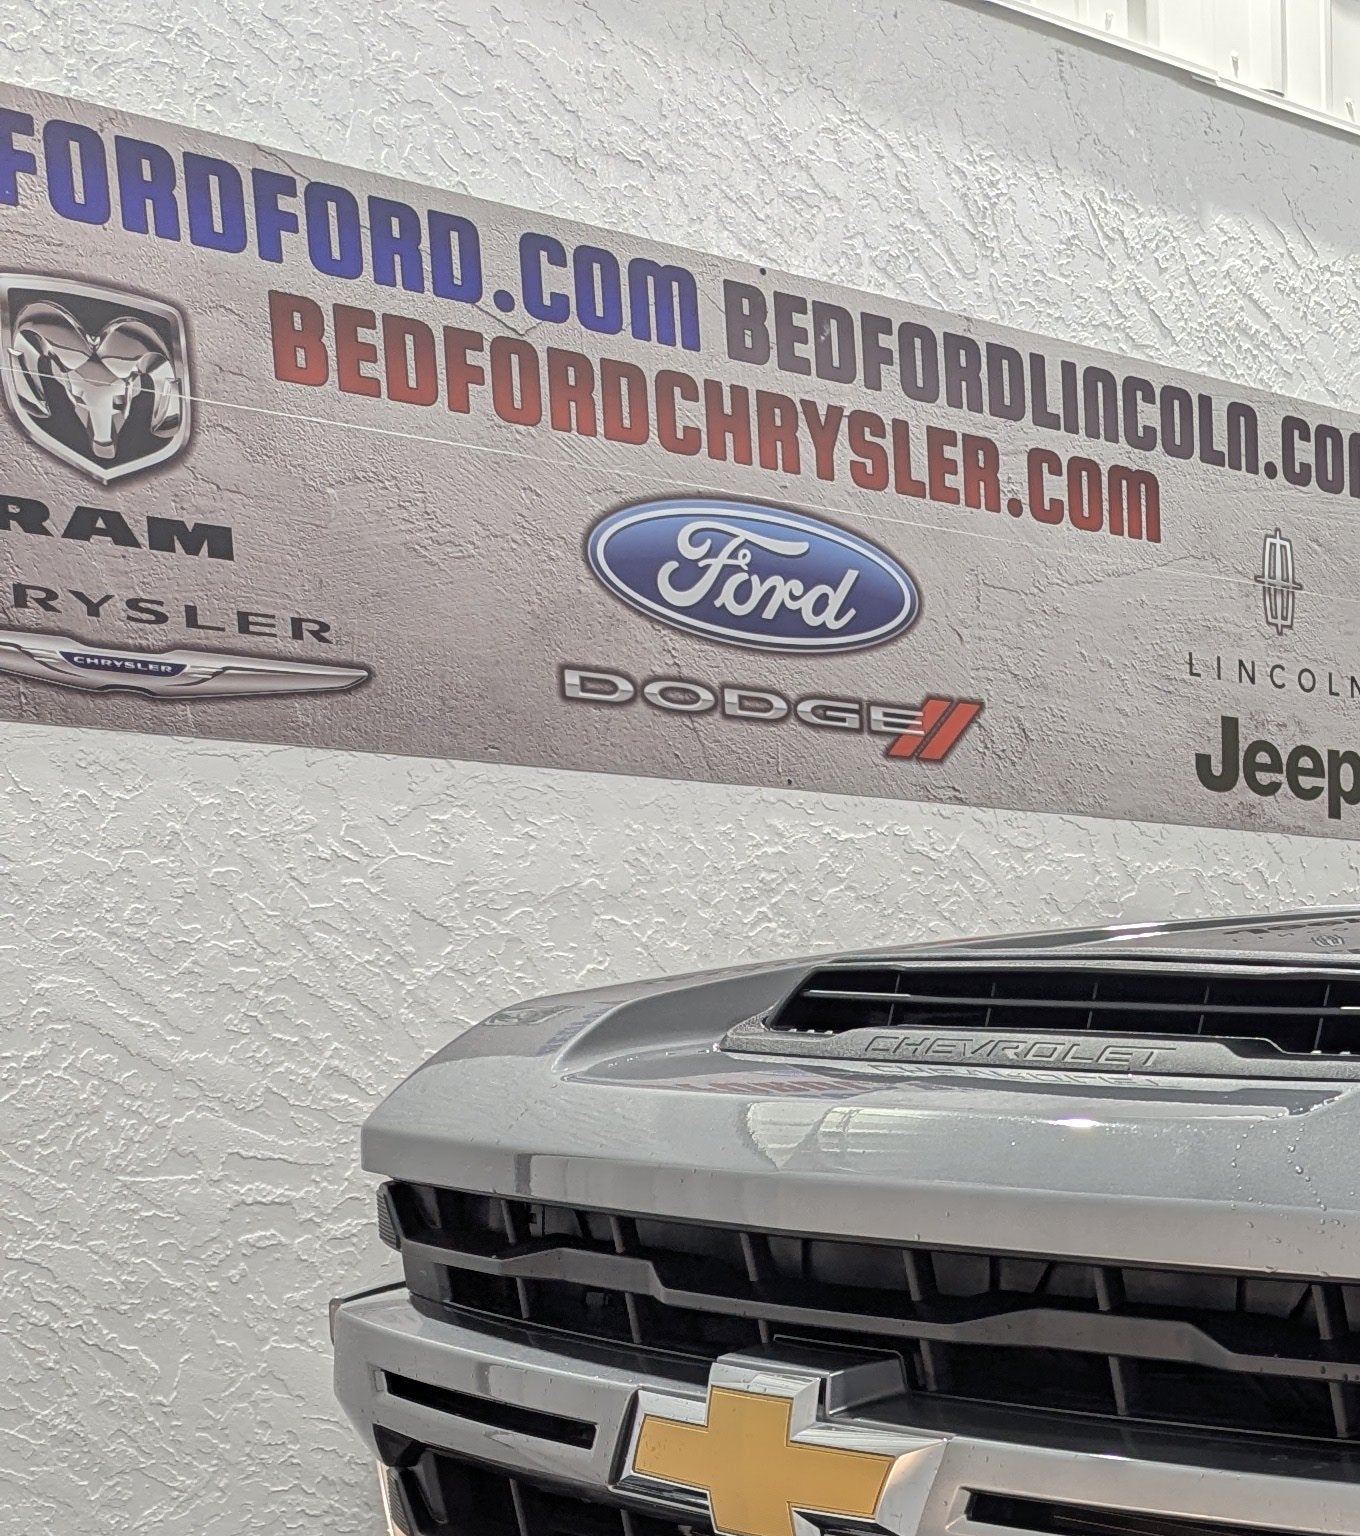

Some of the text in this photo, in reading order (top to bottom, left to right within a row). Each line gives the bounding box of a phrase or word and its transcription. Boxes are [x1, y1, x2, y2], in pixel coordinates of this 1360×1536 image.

[268, 289, 1162, 544] BEDFORDCHRYSLER.COM
[0, 494, 235, 562] RAM
[656, 519, 860, 631] Ford
[73, 654, 173, 675] CHRYSLER
[563, 668, 926, 737] DODGE
[864, 1035, 1178, 1067] CHEVROLET
